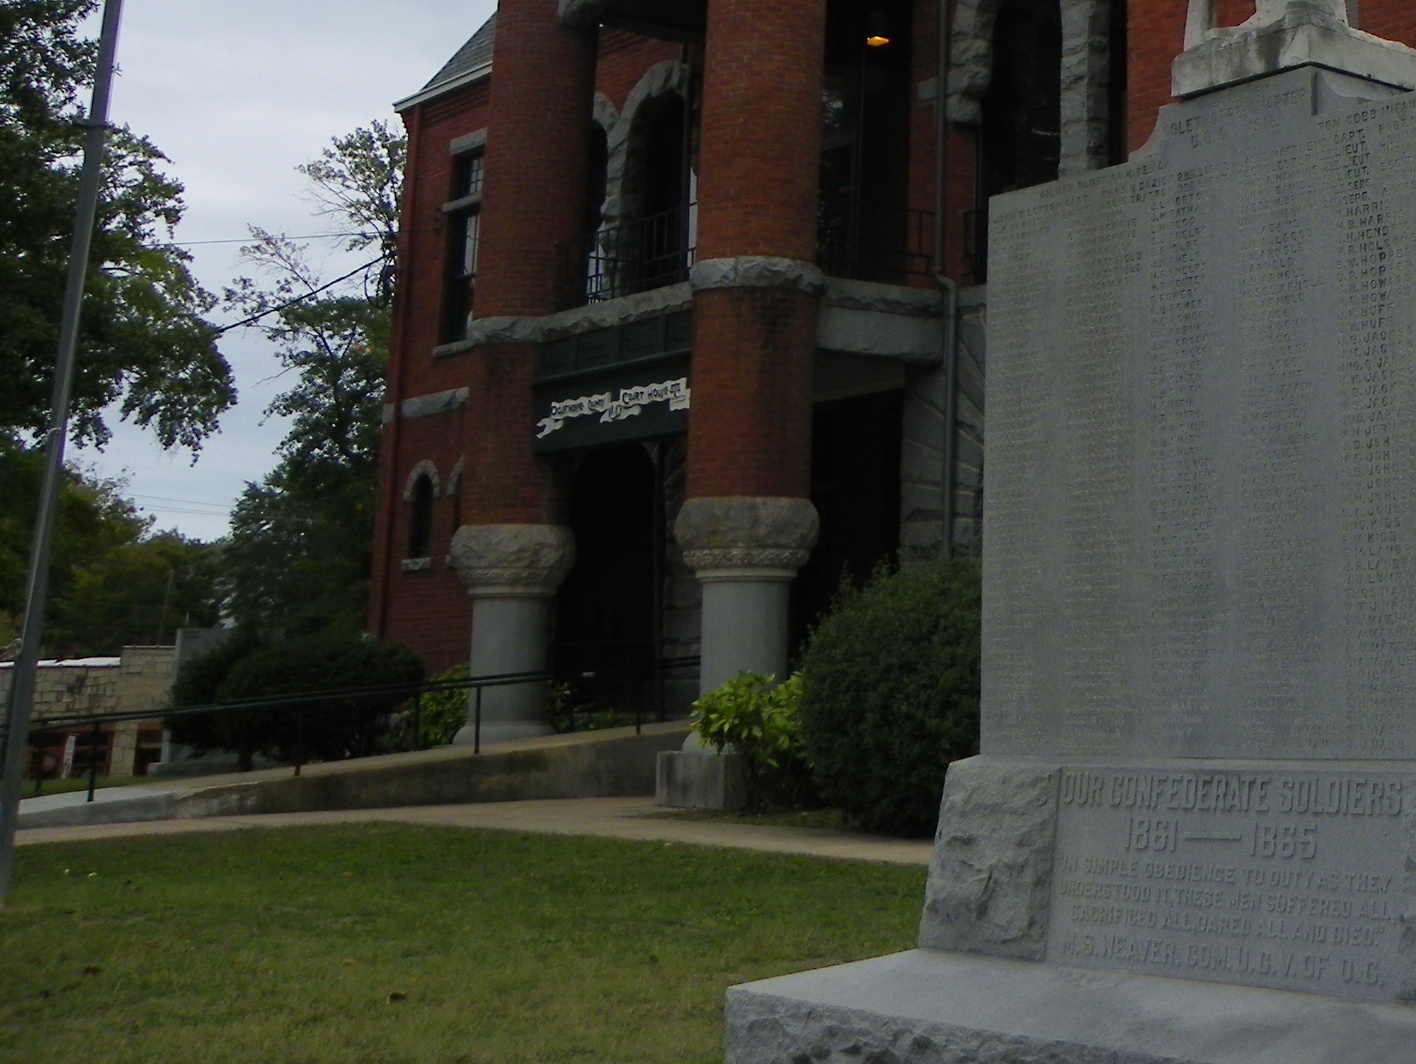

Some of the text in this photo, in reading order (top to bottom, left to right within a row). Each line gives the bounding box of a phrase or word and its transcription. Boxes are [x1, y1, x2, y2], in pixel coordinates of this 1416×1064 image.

[1334, 129, 1366, 144] CAPT.
[1062, 771, 1403, 817] OUR CONFEDERATE SOLDIERS
[1124, 817, 1318, 859] 1861 1865
[1083, 858, 1140, 878] SIMPLE
[1145, 861, 1236, 884] OBEDIENCE
[1246, 868, 1266, 886] TO
[1270, 870, 1315, 889] DUTY
[1317, 872, 1341, 892] AS
[1345, 873, 1393, 893] THEY
[1060, 879, 1151, 904] UNDERSTOOD
[1175, 888, 1224, 909] THESE
[1229, 891, 1262, 911] MEN
[1266, 894, 1353, 919] SUFFERED
[1071, 904, 1158, 929] SACRIFICED
[1198, 913, 1252, 937] DARED
[1256, 920, 1289, 941] ALL
[1291, 923, 1328, 944] AND
[1304, 954, 1330, 981] OF
